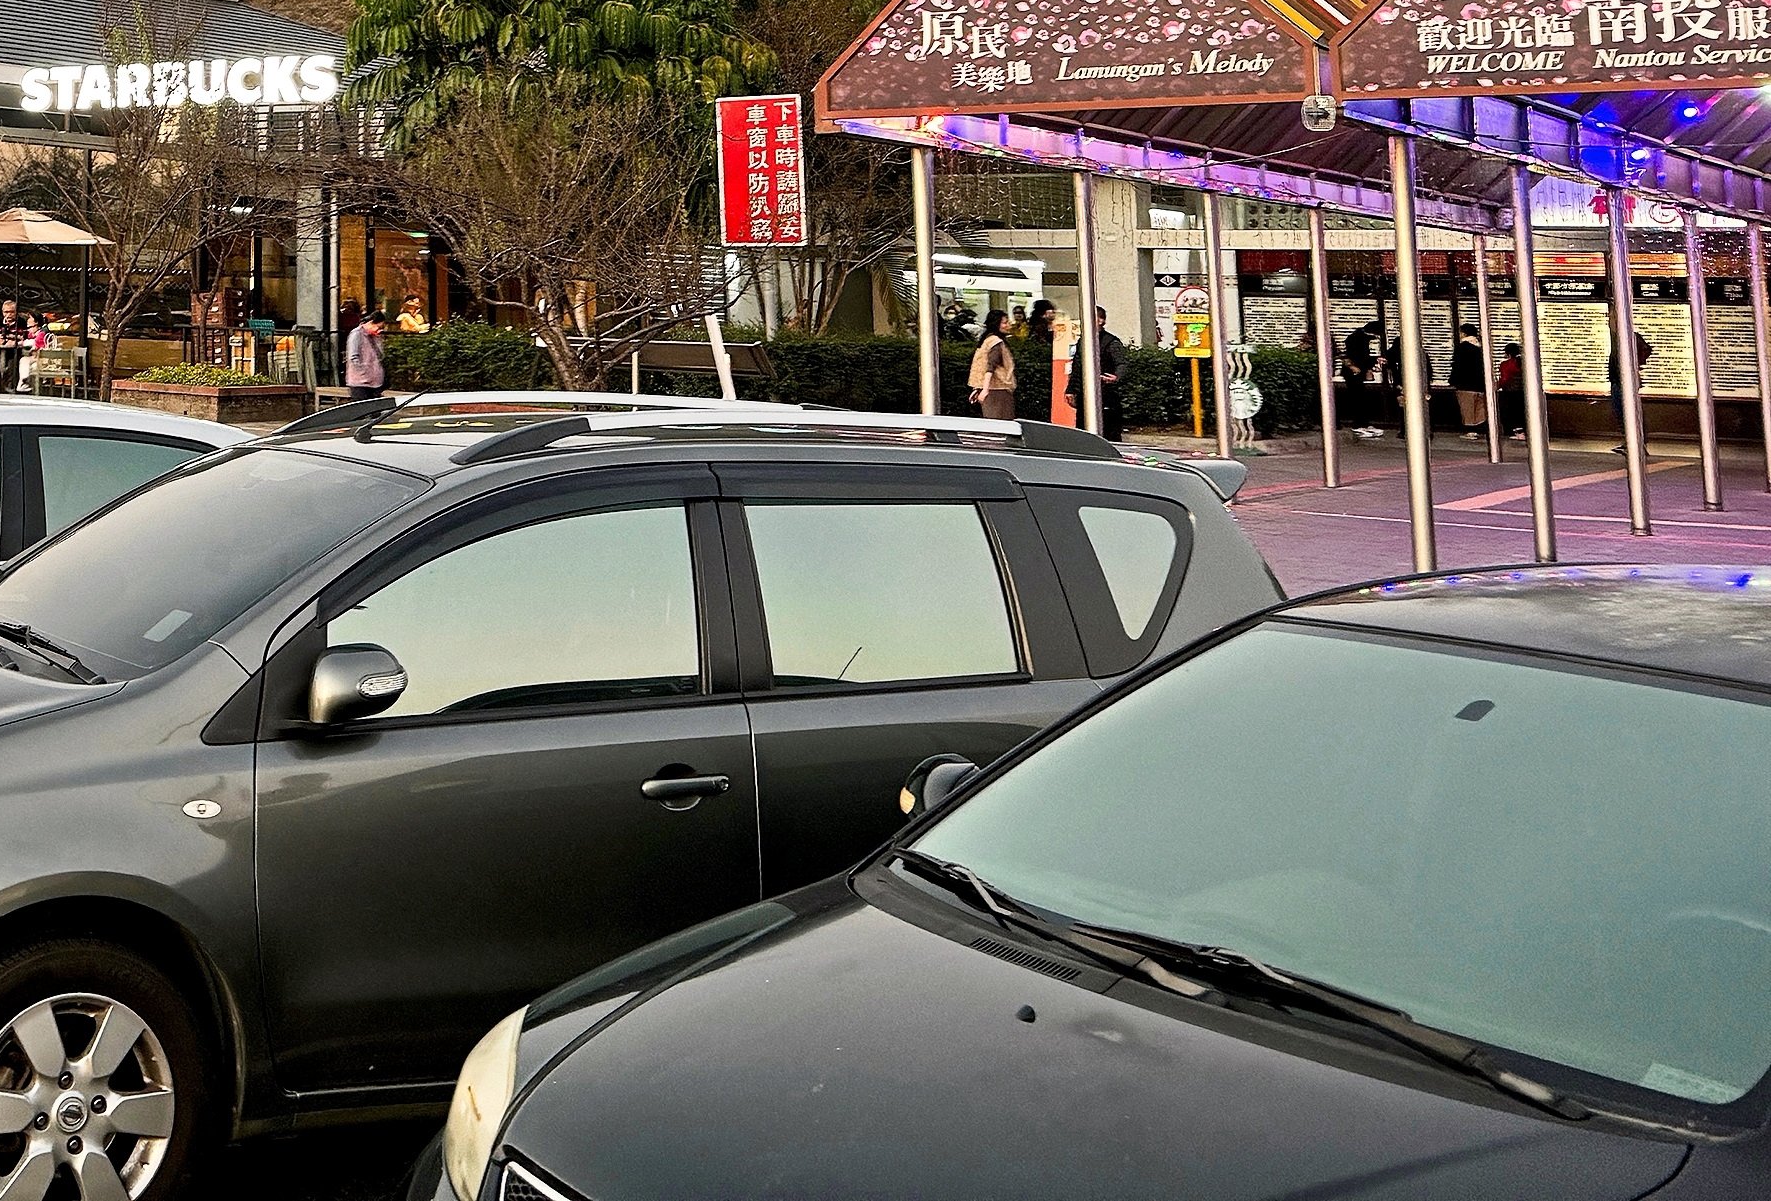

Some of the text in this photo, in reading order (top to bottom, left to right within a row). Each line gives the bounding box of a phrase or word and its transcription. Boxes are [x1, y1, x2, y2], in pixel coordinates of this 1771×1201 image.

[919, 5, 1010, 60] 原民
[1416, 14, 1575, 53] 歡迎光臨
[951, 60, 1033, 93] 美樂地
[1055, 49, 1274, 83] Lamungan's Melody
[1427, 50, 1565, 74] WELCOME
[1593, 46, 1687, 69] Nantou
[19, 53, 341, 113] STARBUCKS
